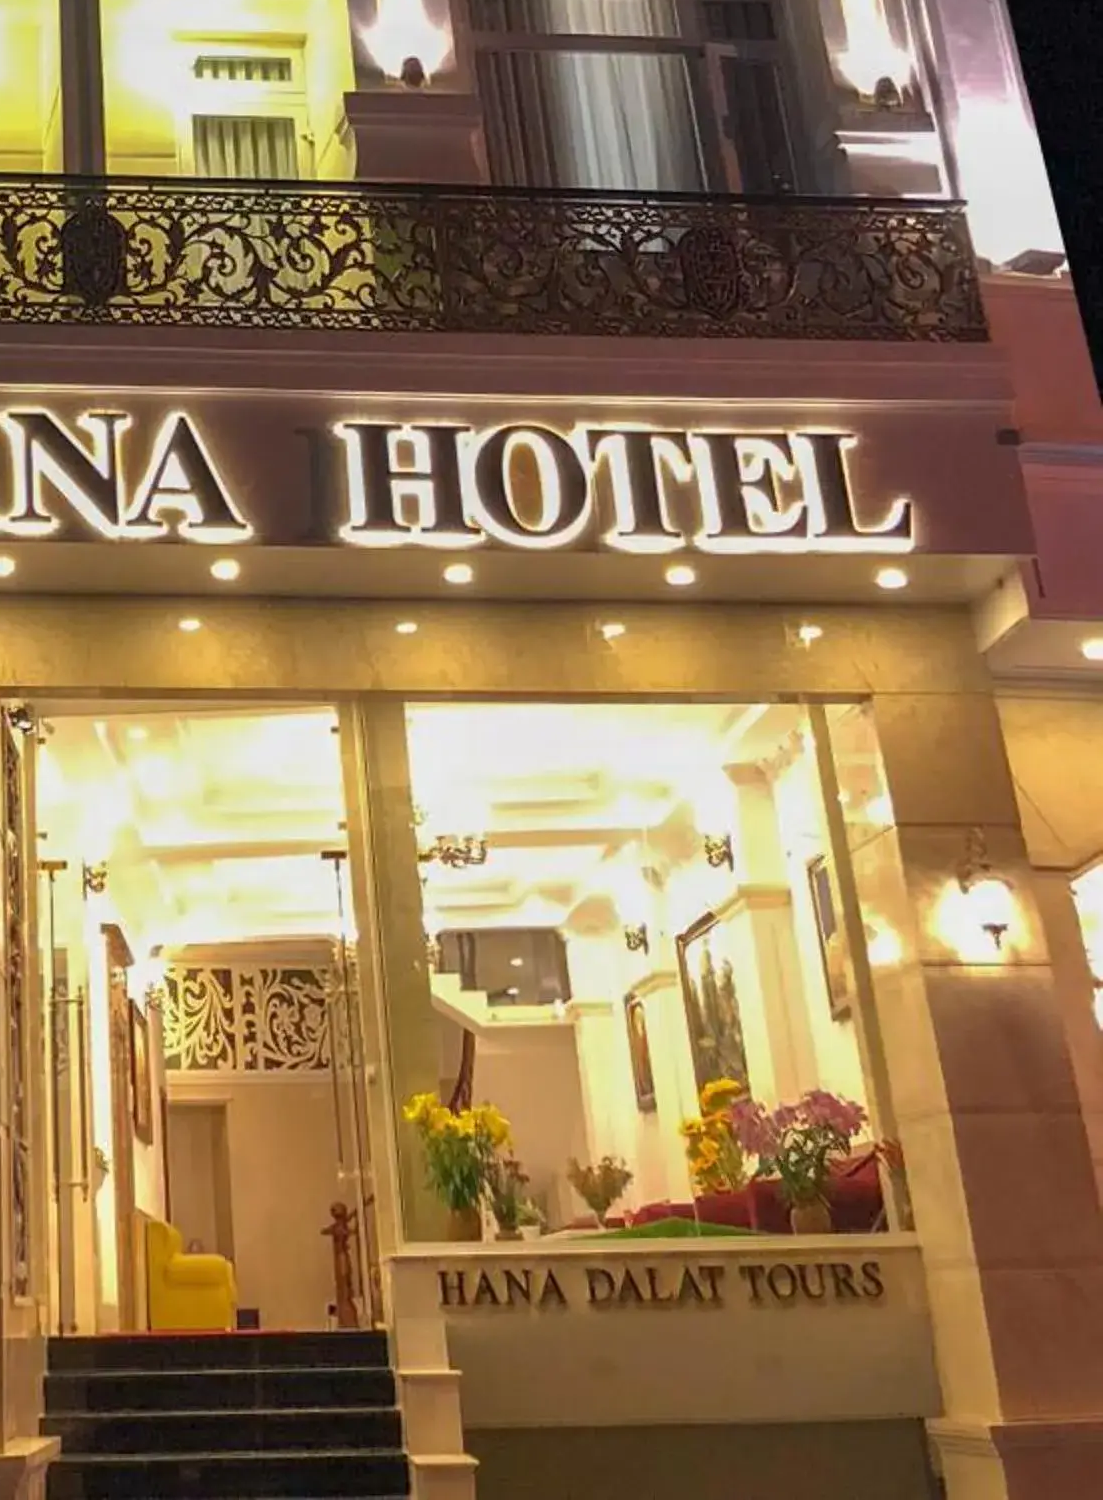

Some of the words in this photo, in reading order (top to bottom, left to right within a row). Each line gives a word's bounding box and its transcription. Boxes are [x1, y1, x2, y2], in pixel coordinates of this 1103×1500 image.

[334, 421, 914, 552] HOTEL
[438, 1269, 565, 1308] HANA
[585, 1266, 724, 1306] DALAT
[740, 1261, 885, 1302] TOURS
